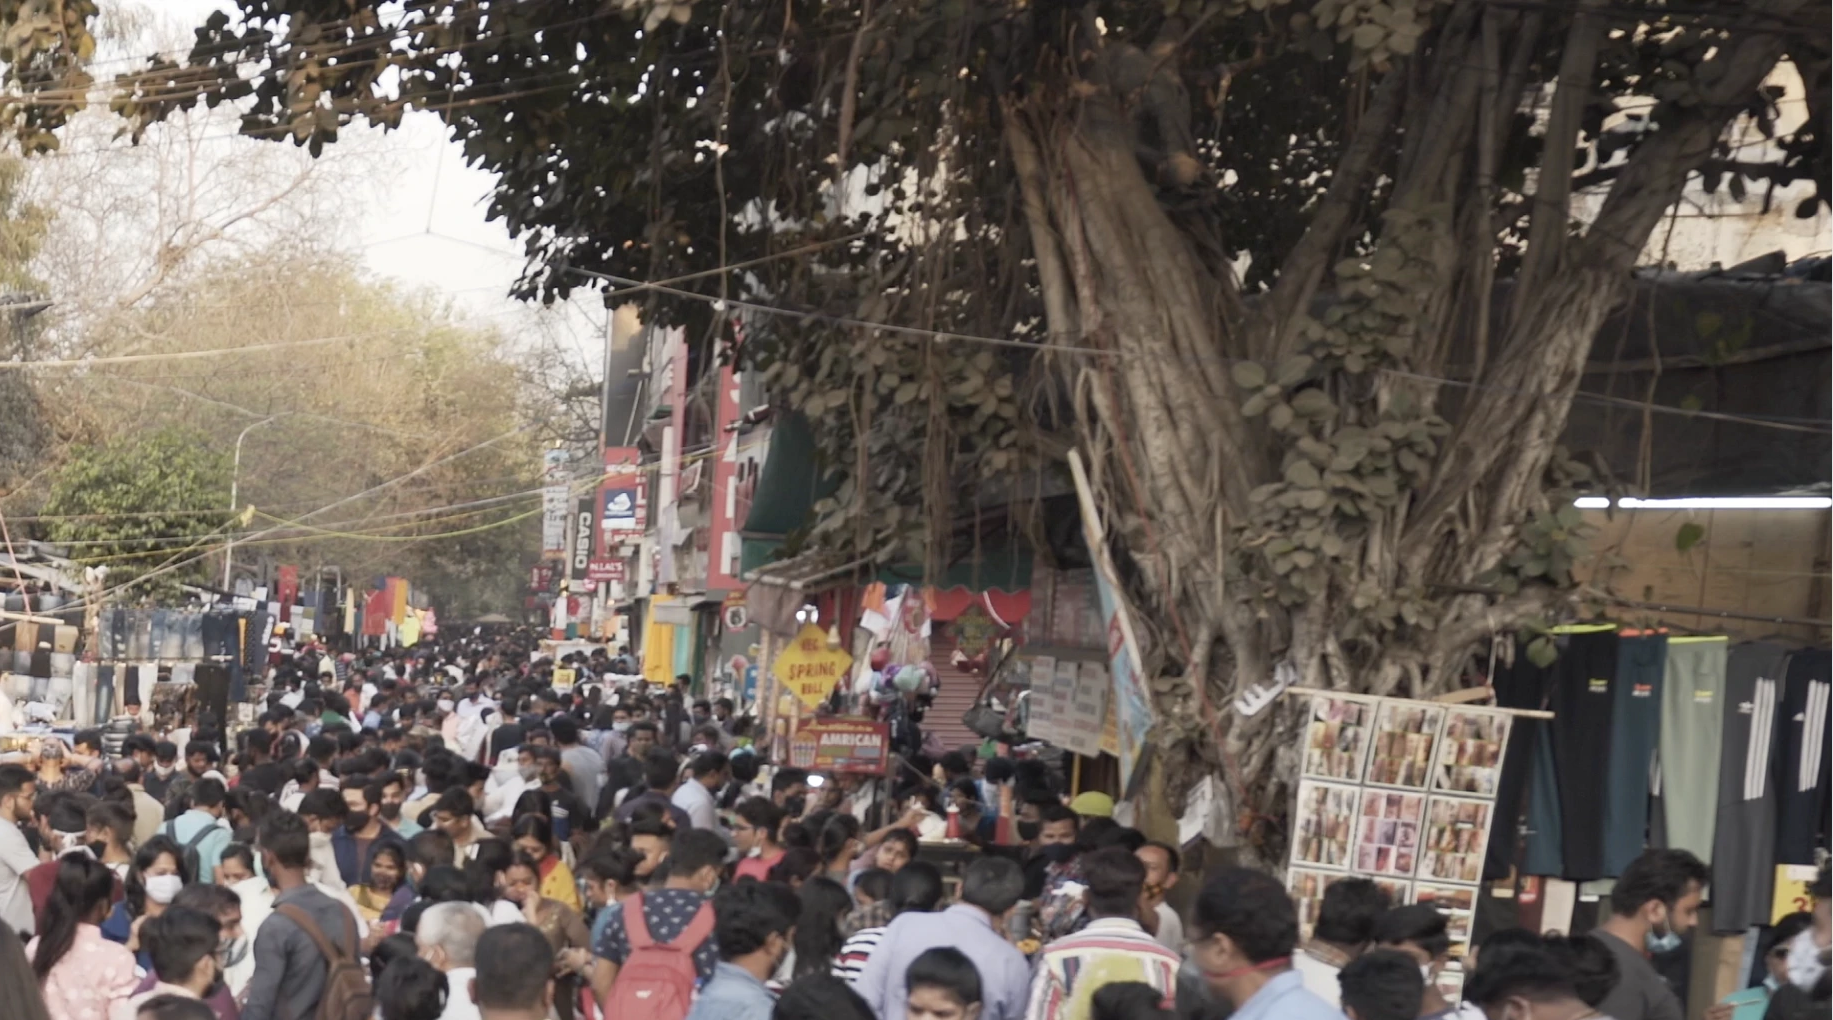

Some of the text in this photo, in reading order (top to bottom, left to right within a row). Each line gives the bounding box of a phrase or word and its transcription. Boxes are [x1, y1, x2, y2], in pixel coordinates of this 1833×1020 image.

[575, 512, 592, 569] CASIO
[789, 660, 836, 680] SPRING
[819, 733, 883, 746] AMRICAN
